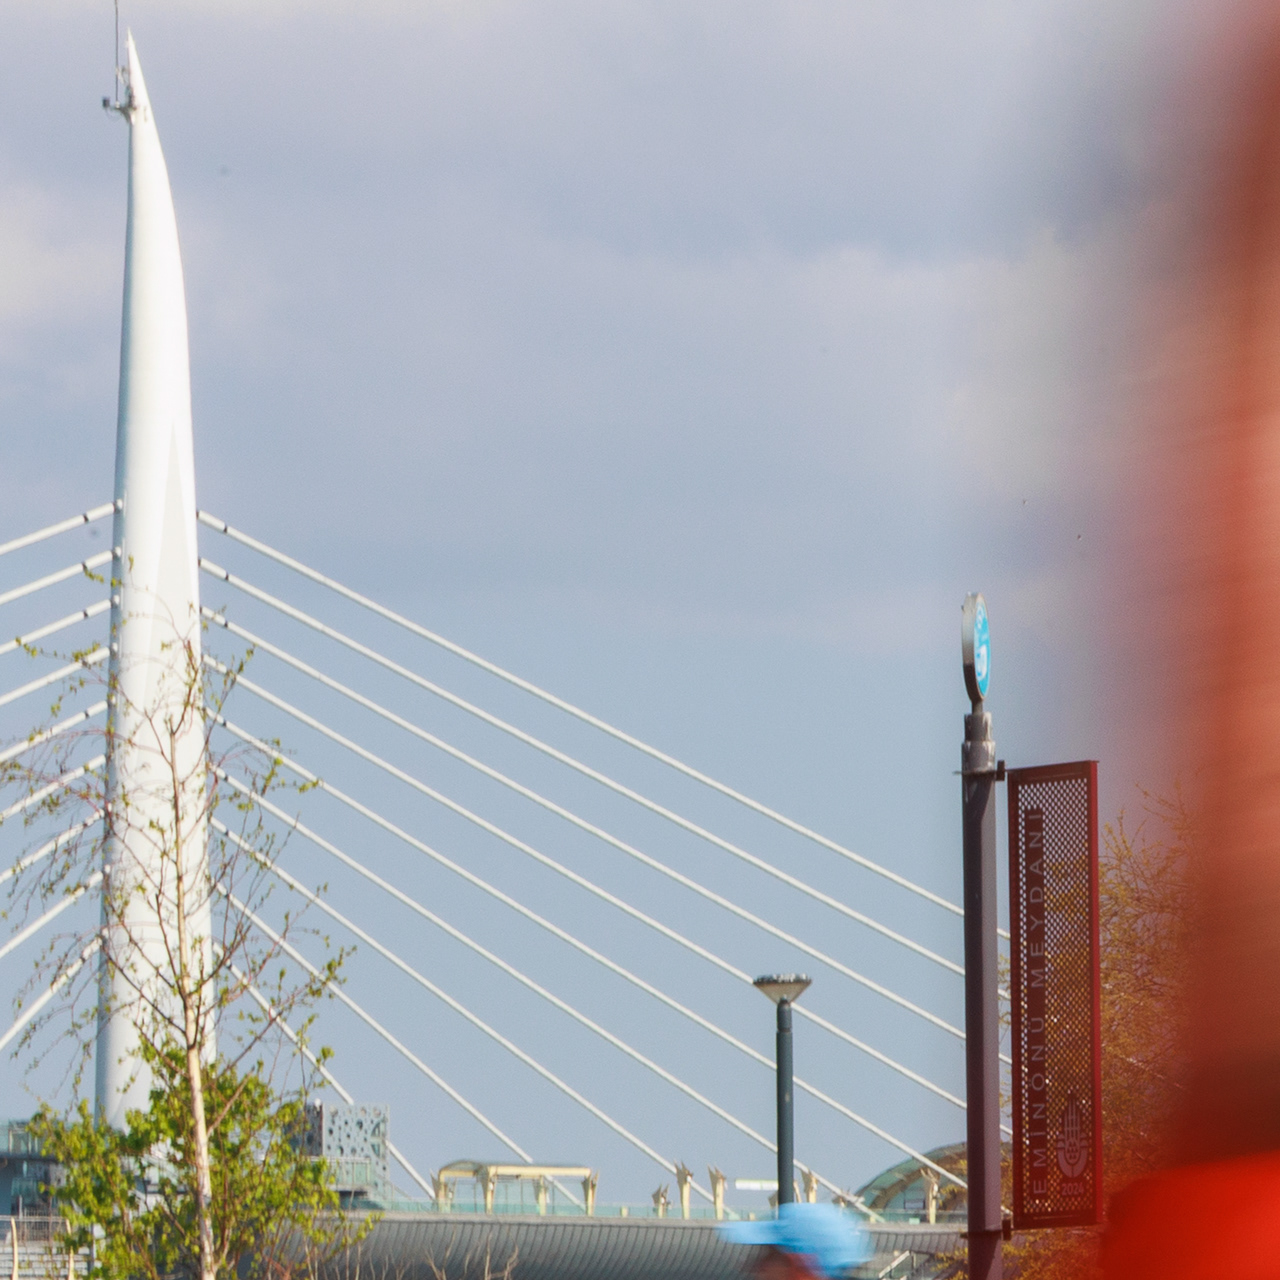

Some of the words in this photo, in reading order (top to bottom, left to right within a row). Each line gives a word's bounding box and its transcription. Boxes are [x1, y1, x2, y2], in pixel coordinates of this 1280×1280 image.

[1029, 814, 1044, 988] MEYDANI
[1028, 1017, 1047, 1194] EMİNÖNÜ
[1061, 1183, 1085, 1196] 2024
